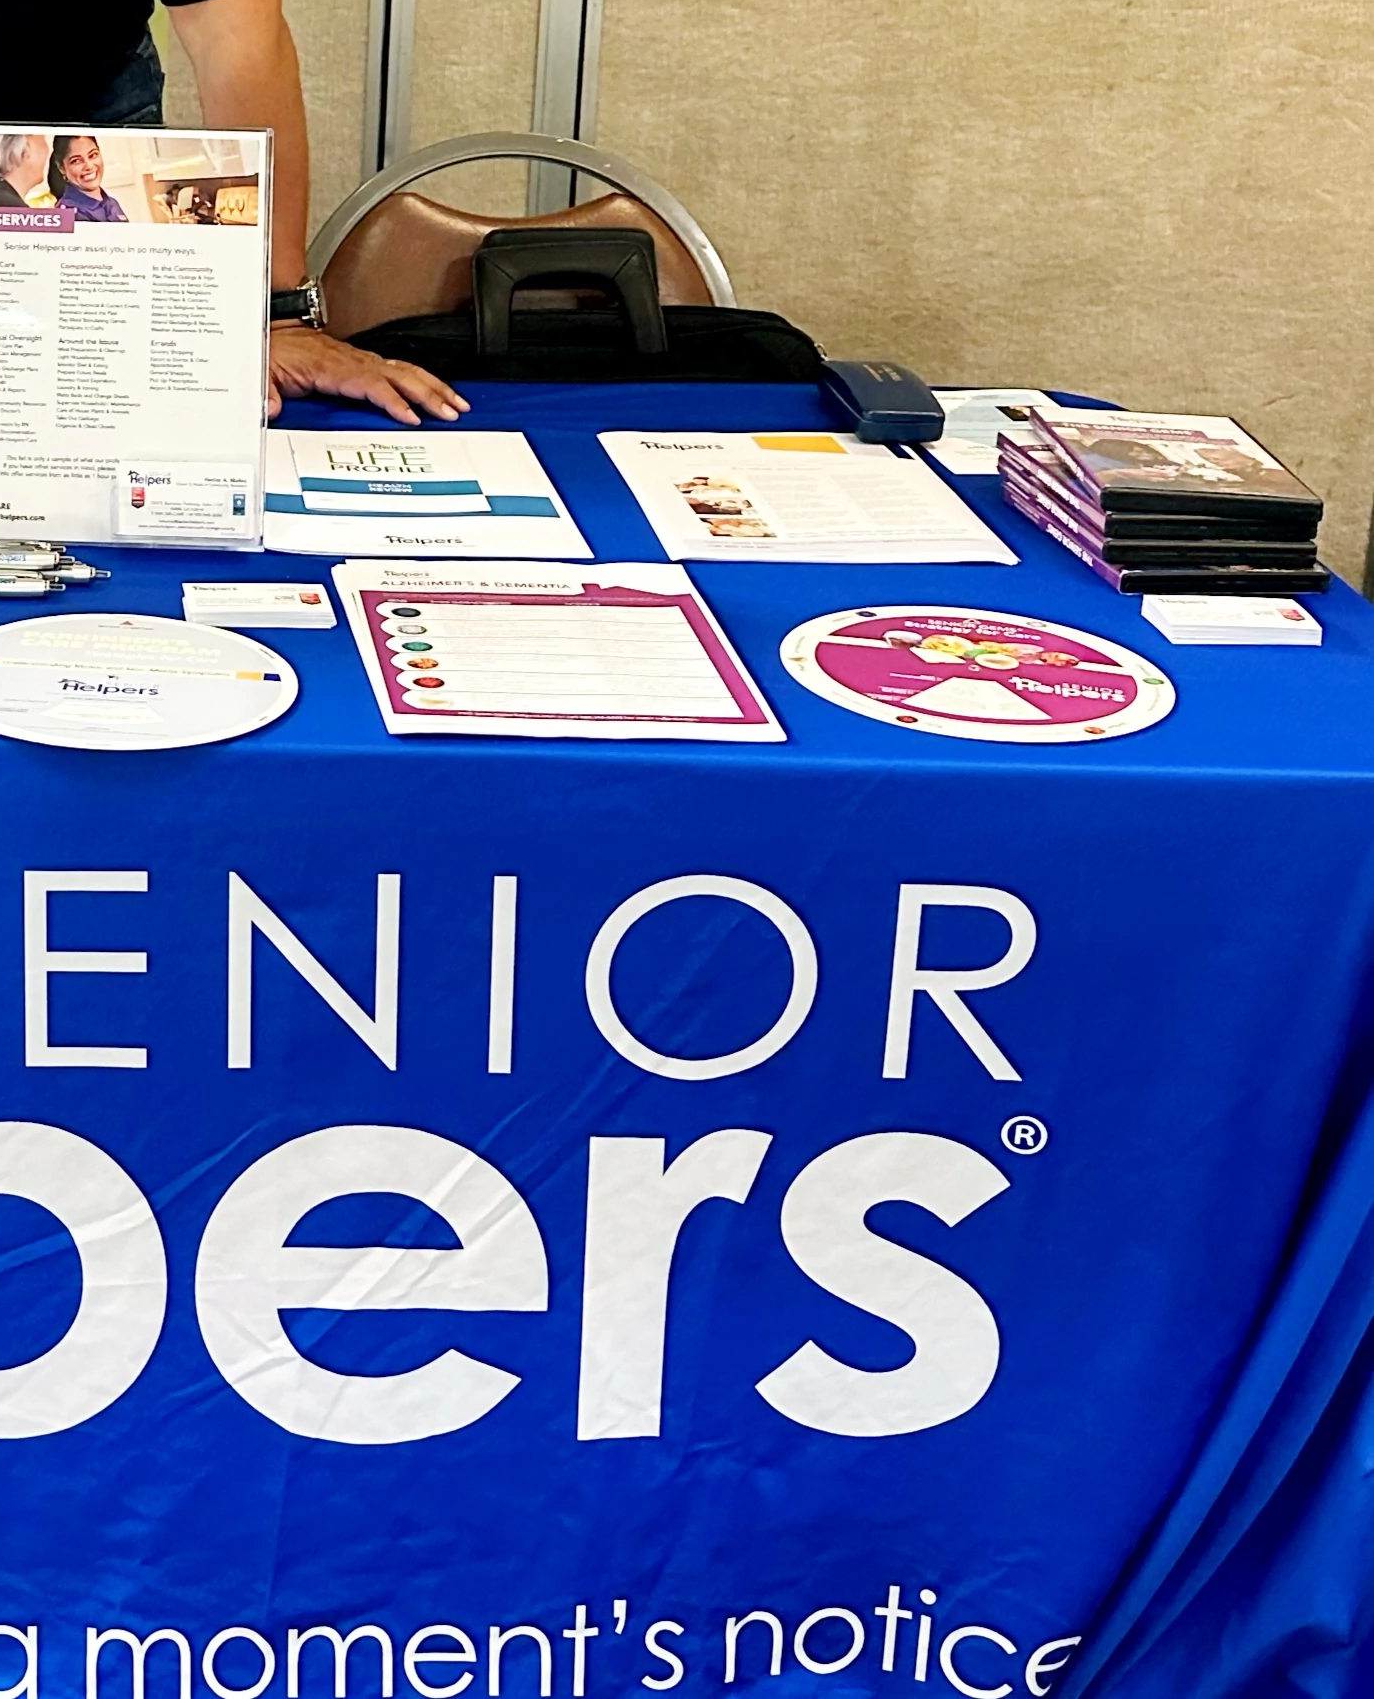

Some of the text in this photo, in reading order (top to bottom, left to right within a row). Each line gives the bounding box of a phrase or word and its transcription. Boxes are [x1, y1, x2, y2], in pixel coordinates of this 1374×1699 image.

[645, 441, 724, 451] Helpers
[327, 451, 432, 465] LIFE
[330, 464, 434, 473] PROFILE
[130, 475, 171, 486] Helpers
[62, 682, 159, 695] Helpers
[1016, 680, 1127, 702] Helpers
[83, 1599, 686, 1699] moment's
